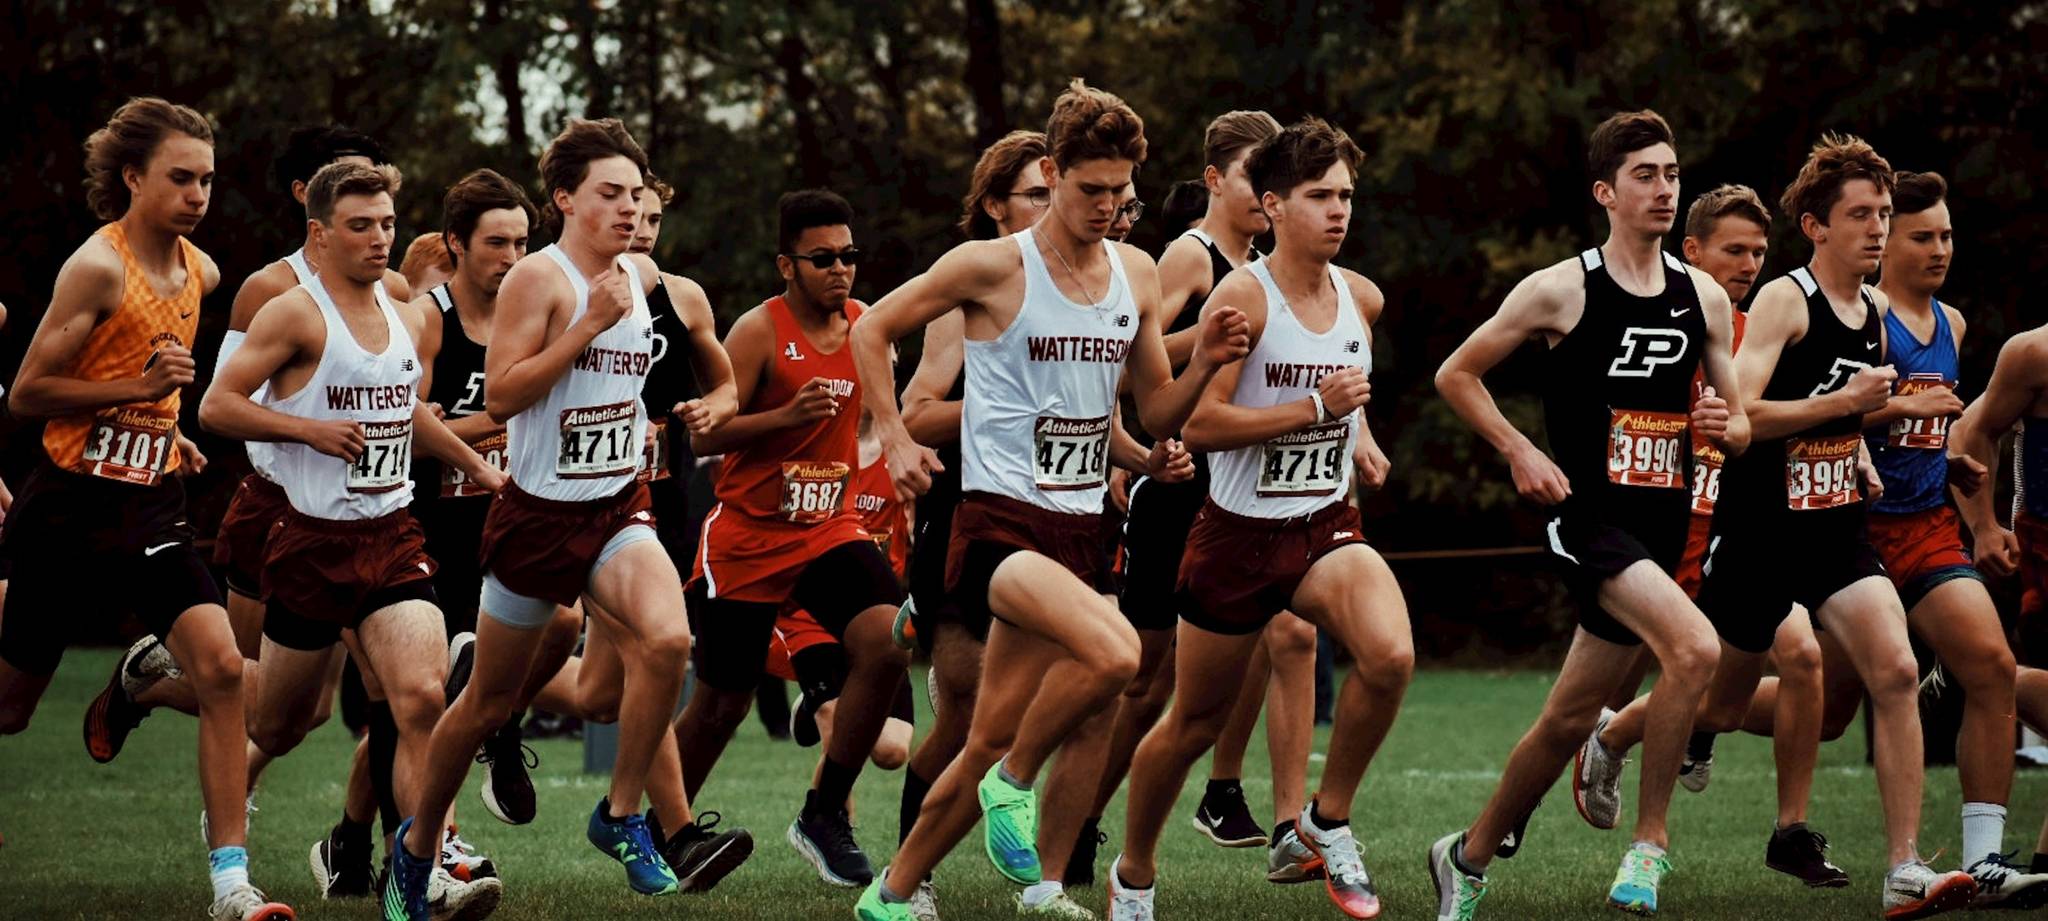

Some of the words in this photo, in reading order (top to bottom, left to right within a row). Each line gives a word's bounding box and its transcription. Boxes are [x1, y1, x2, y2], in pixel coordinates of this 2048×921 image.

[1608, 327, 1689, 377] P
[1265, 363, 1364, 389] WATTE
[563, 403, 634, 426] Athletic.net
[92, 426, 167, 471] 3101
[563, 425, 632, 464] 4717
[1037, 439, 1106, 475] 4718
[1267, 446, 1340, 482] 4719
[787, 482, 843, 512] 3687
[1692, 464, 1722, 501] 36
